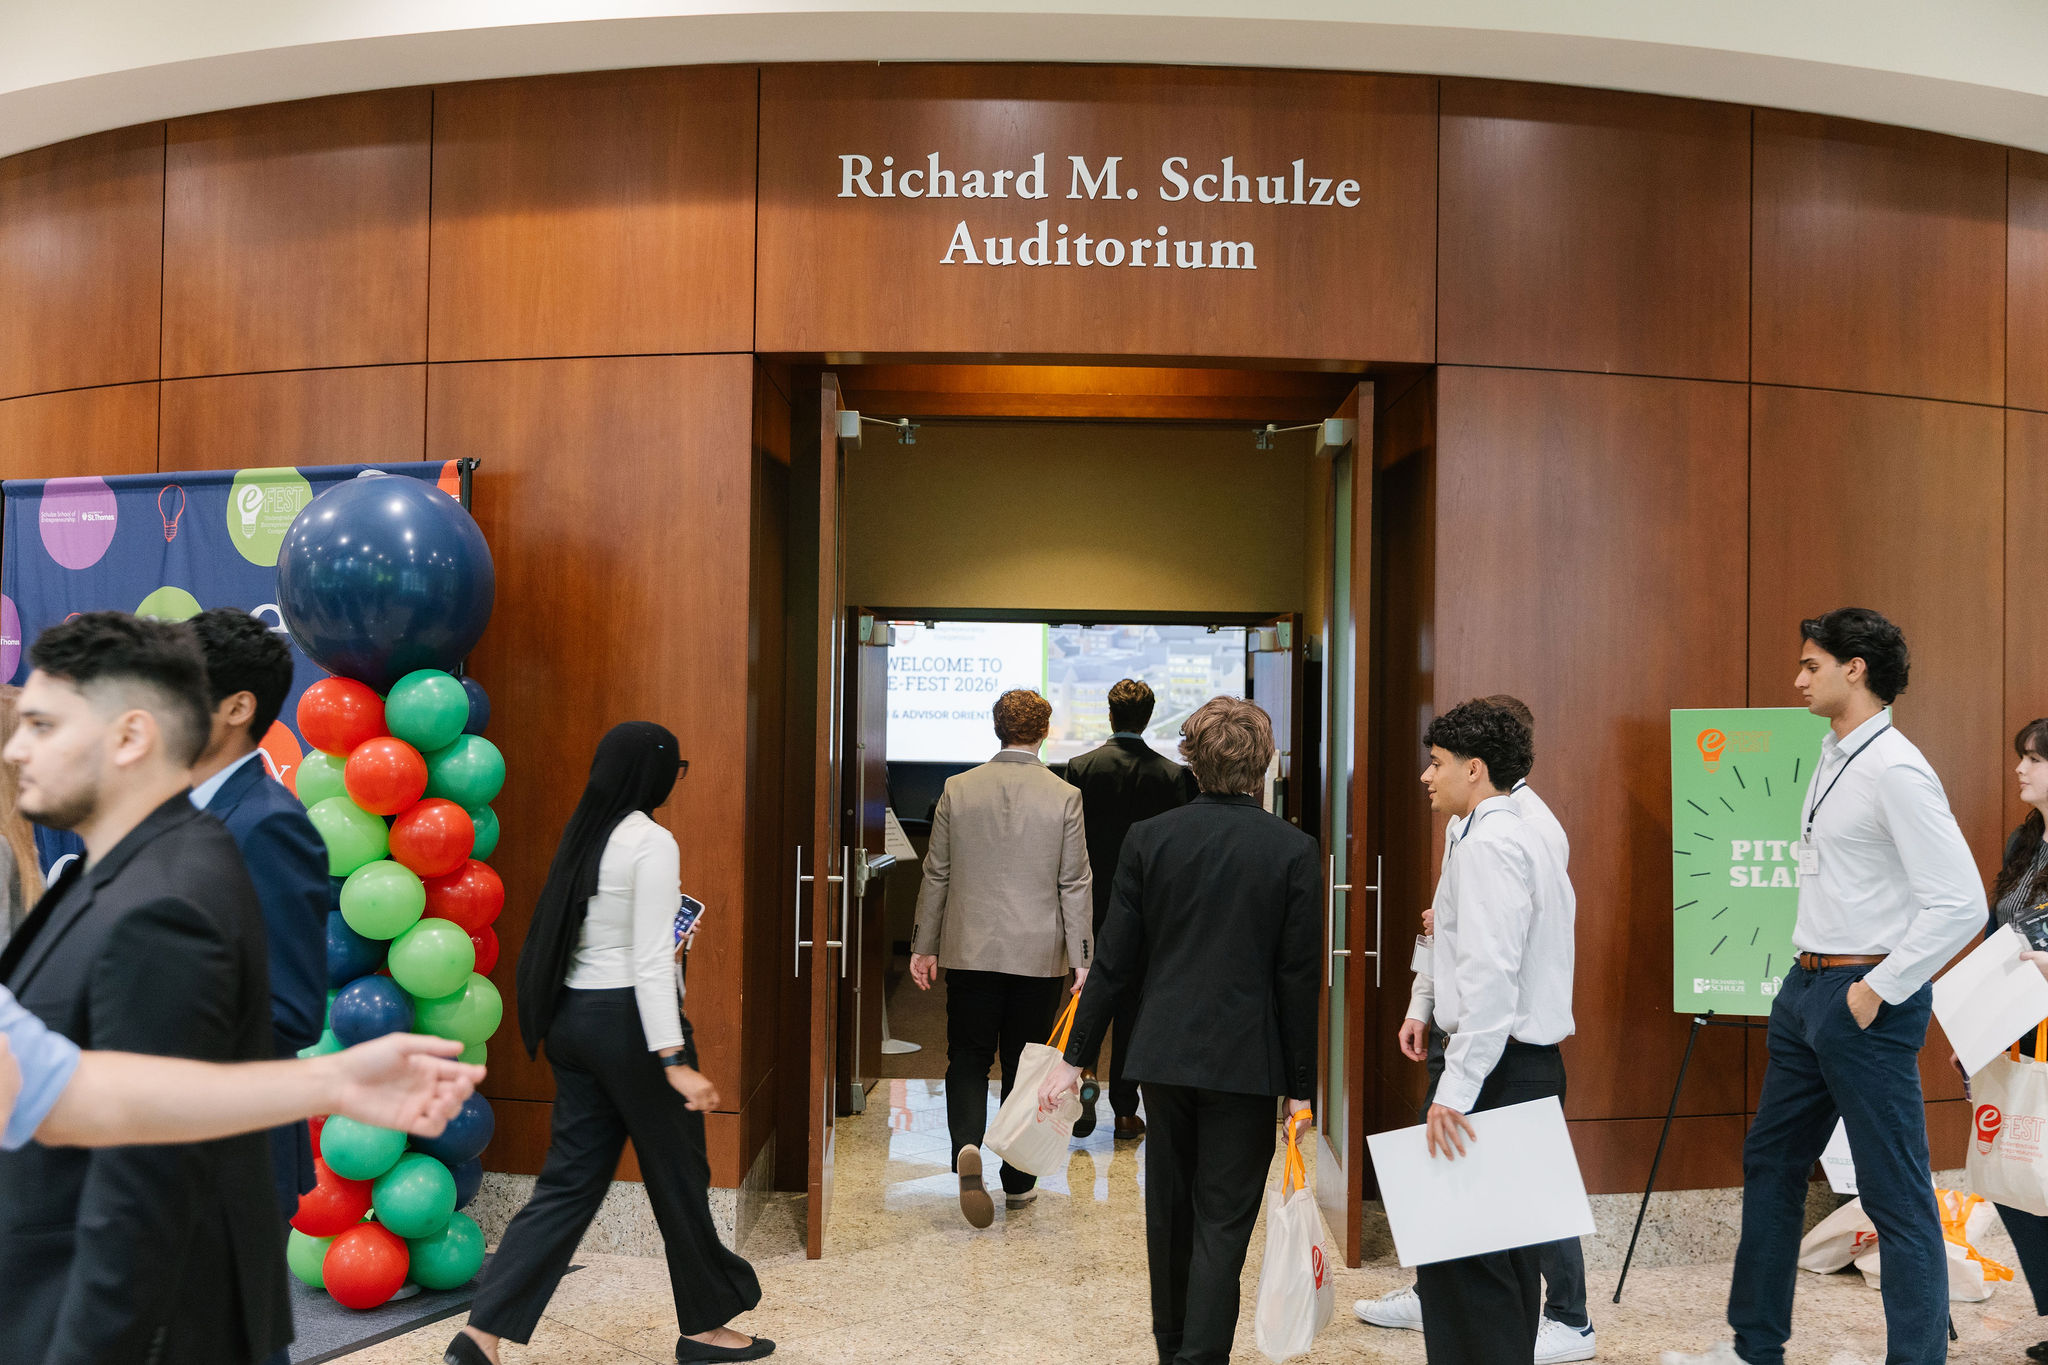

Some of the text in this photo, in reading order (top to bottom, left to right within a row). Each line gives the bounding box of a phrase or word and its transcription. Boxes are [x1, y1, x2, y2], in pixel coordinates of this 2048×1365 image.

[837, 152, 1361, 208] Richard M. Schulze
[939, 218, 1258, 270] Auditorium
[887, 656, 1002, 673] WELCOME TO
[887, 676, 999, 692] E-FEST 2026!
[902, 710, 949, 720] ADVISOR
[951, 711, 994, 721] ORIENT
[1729, 866, 1800, 888] SLA
